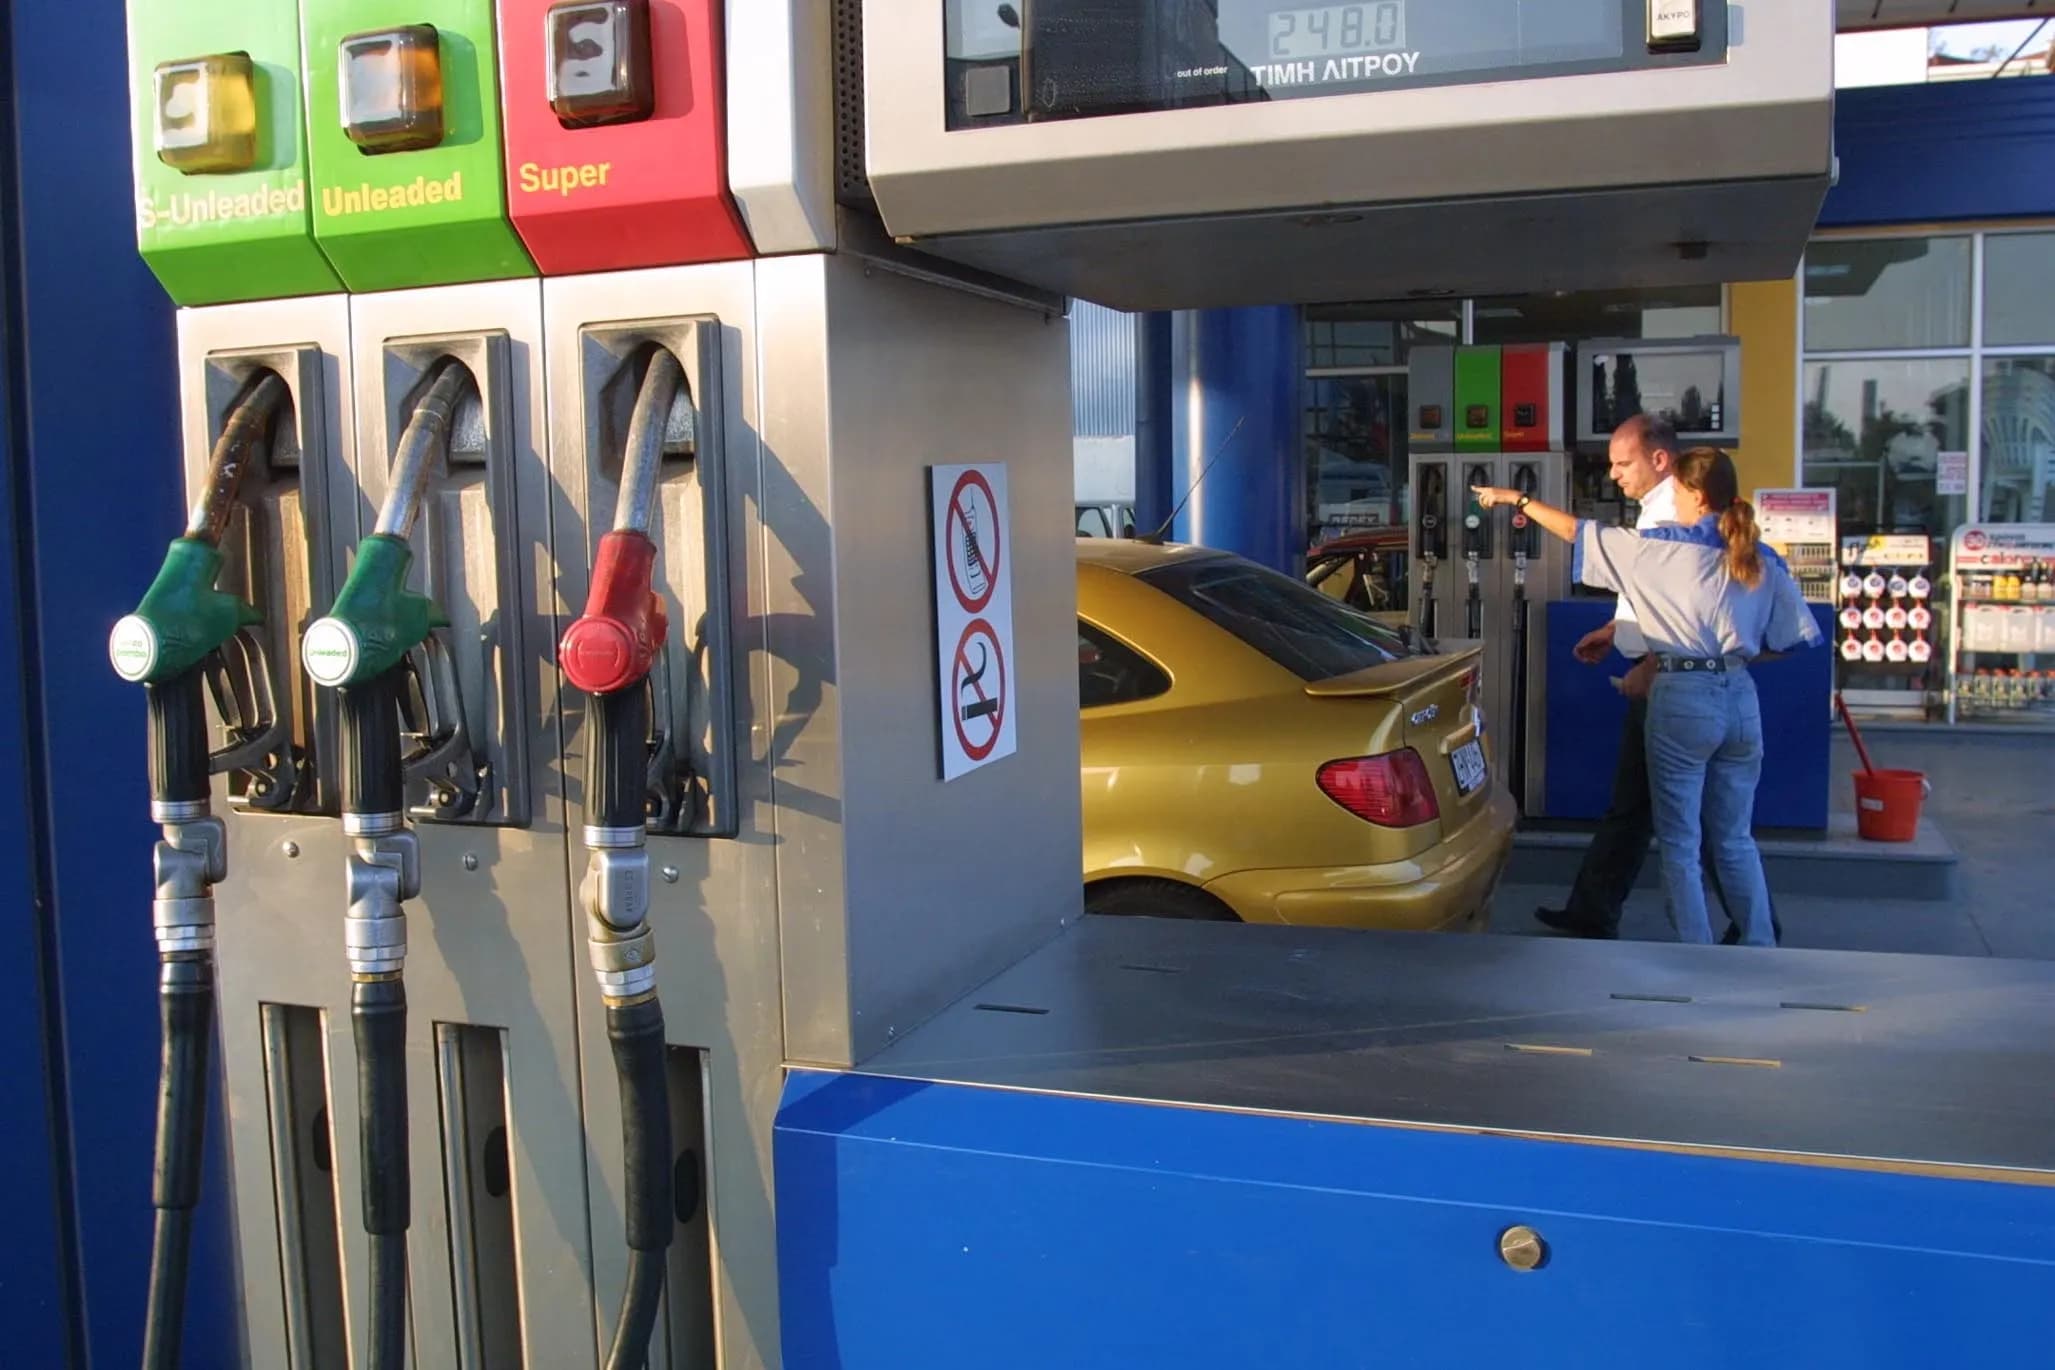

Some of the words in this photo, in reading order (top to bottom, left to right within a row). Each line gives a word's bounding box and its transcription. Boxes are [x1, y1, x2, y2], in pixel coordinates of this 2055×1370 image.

[1272, 3, 1399, 57] 248.0
[1177, 69, 1191, 79] out
[1192, 67, 1203, 77] of
[1203, 65, 1228, 76] order
[1251, 60, 1315, 87] ΤΙΜΗ
[1322, 51, 1421, 81] ΛΙΤΡΟΥ
[323, 172, 462, 216] Unleaded
[519, 162, 611, 196] Super
[139, 178, 305, 227] S-Unleaded
